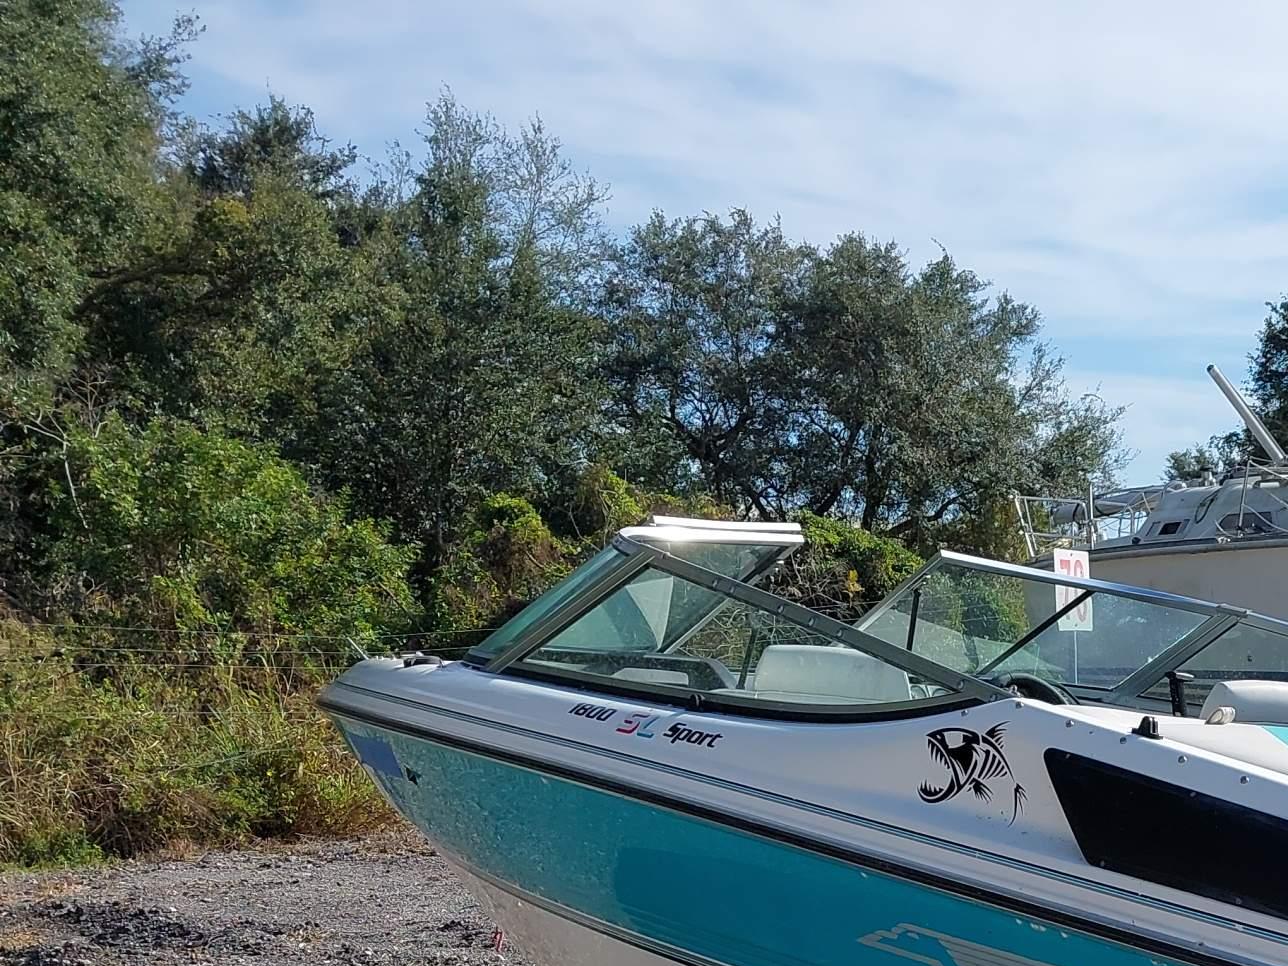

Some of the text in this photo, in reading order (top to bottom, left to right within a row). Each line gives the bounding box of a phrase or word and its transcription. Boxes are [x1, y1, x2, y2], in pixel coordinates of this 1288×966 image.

[1060, 559, 1088, 622] 70
[568, 702, 724, 748] 1800 SL Sport
